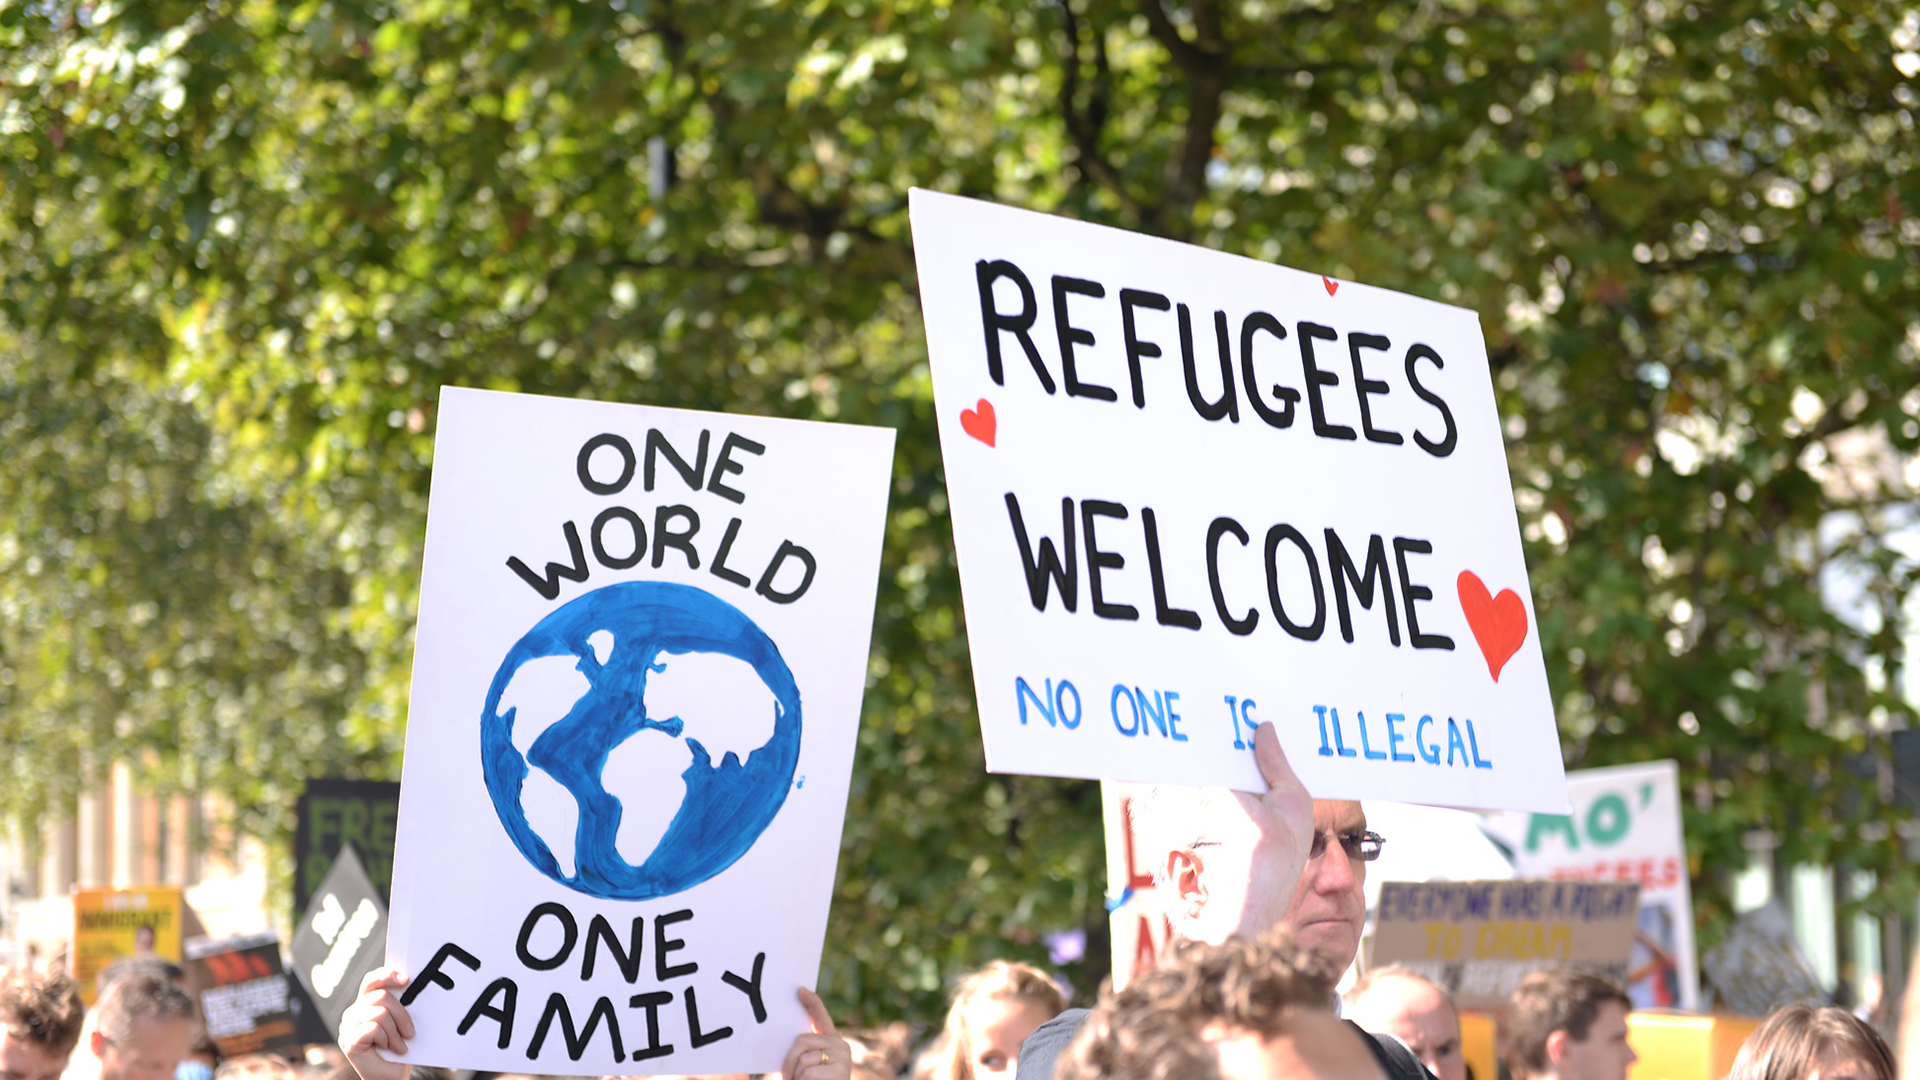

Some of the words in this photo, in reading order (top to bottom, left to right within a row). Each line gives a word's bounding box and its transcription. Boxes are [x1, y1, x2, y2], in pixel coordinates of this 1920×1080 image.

[975, 259, 1458, 458] REFUGEES
[576, 428, 767, 504] ONE
[505, 504, 818, 605] WORLD
[1004, 492, 1456, 651] WELCOME
[1015, 676, 1083, 731] NO
[1111, 683, 1189, 742] ONE
[1224, 694, 1261, 752] IS
[1312, 704, 1494, 770] ILLEGAL
[515, 902, 699, 983] ONE
[400, 943, 768, 1064] FAMILY
